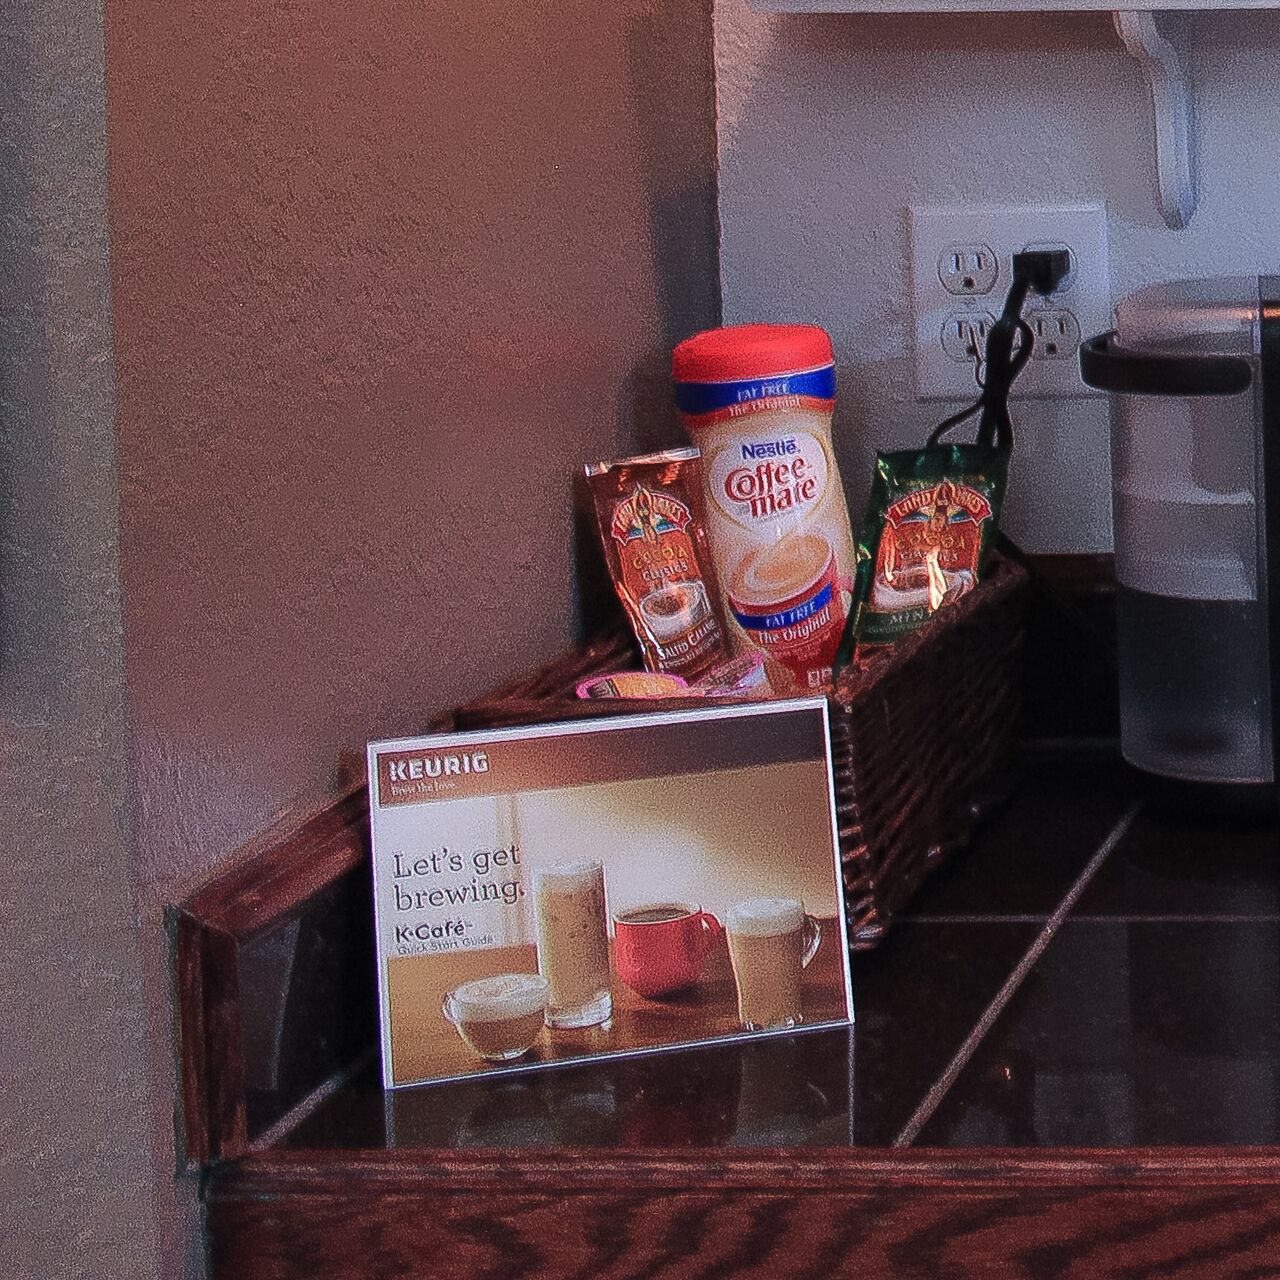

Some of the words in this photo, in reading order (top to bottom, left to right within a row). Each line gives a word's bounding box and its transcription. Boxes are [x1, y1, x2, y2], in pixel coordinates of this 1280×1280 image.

[759, 630, 781, 644] The
[783, 606, 831, 642] Original
[389, 751, 490, 782] KEURIG
[472, 844, 521, 876] get
[393, 879, 526, 912] brewing.
[396, 942, 428, 956] Quick
[431, 937, 459, 952] Start
[462, 934, 494, 948] Guide
